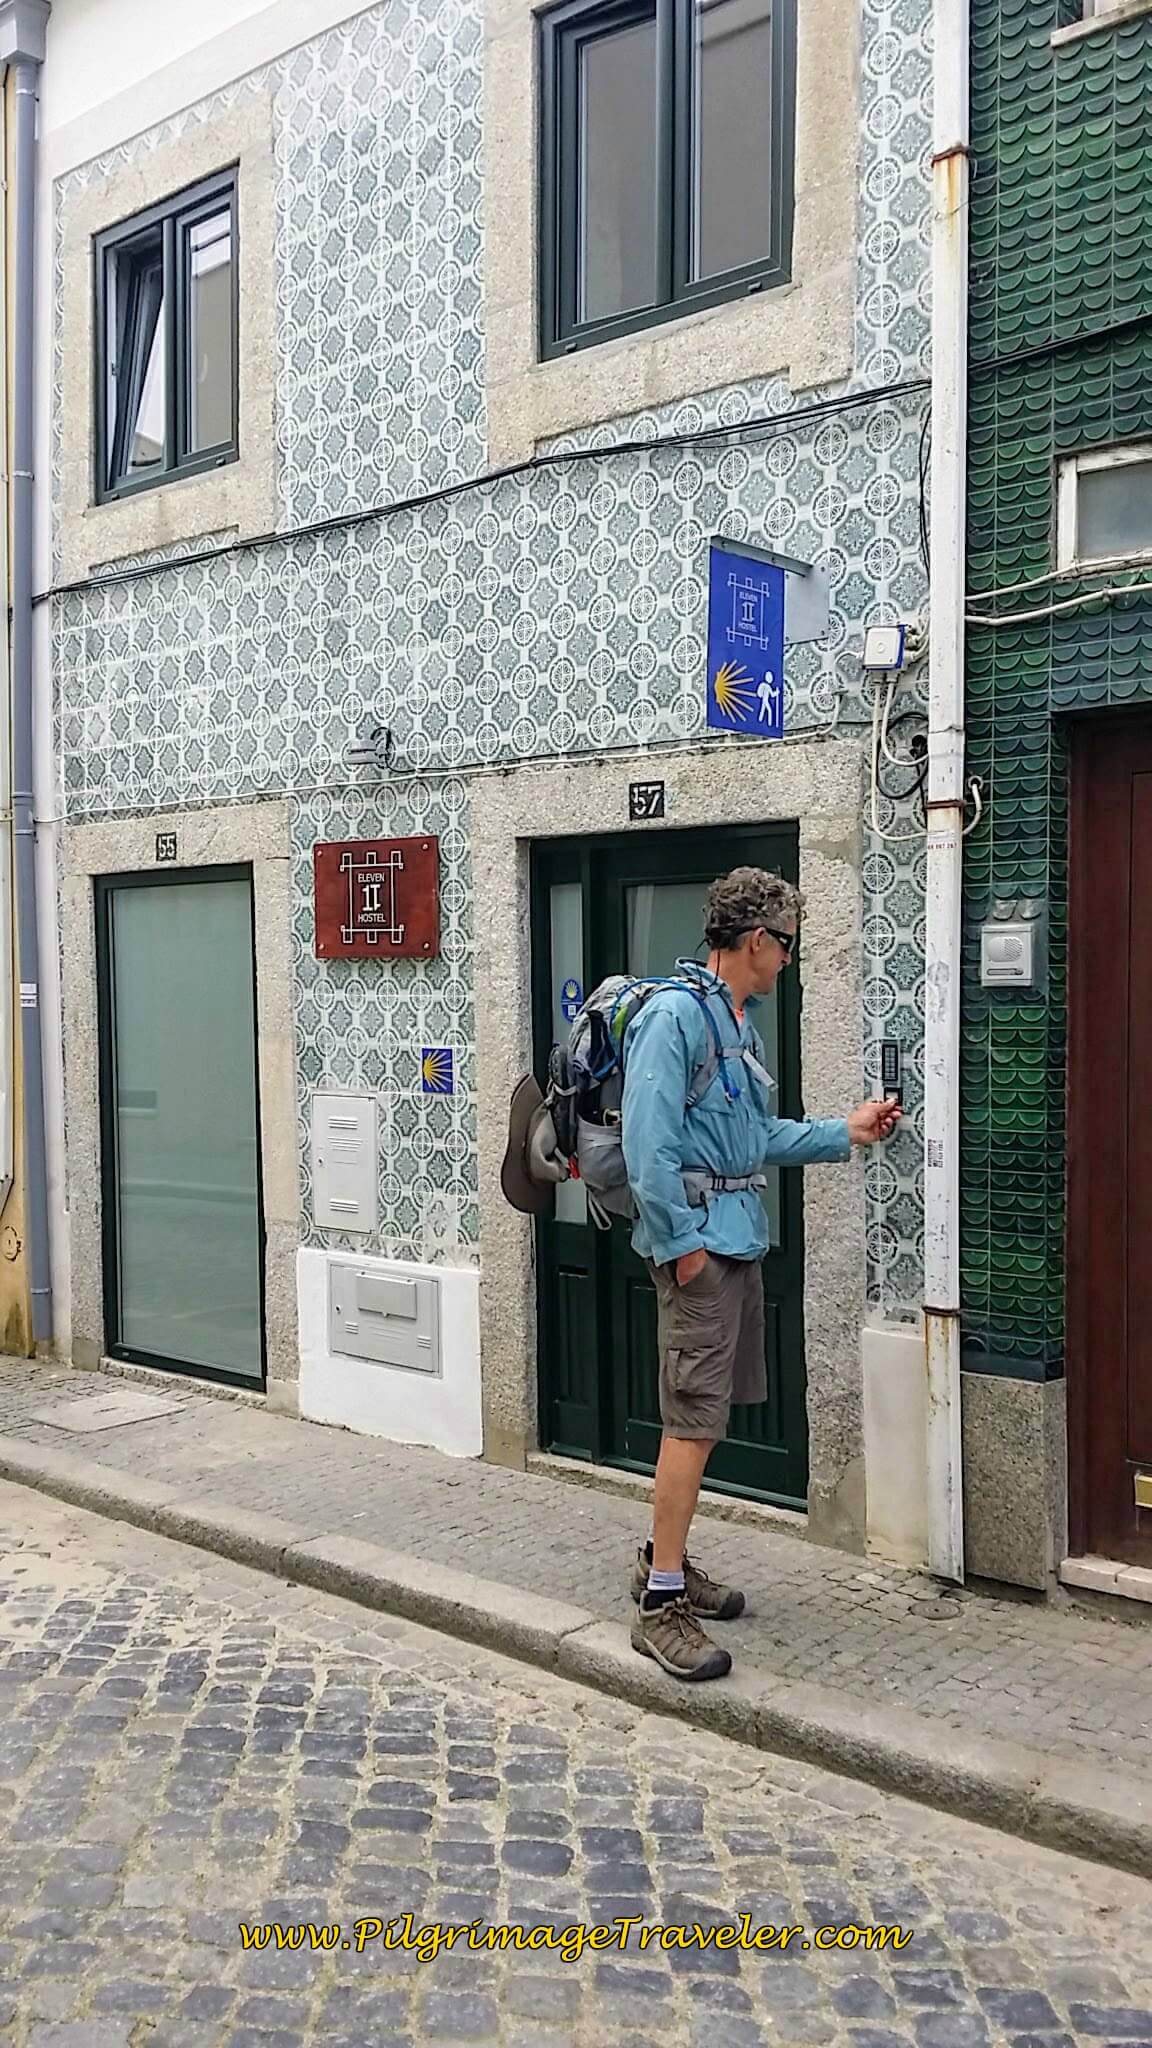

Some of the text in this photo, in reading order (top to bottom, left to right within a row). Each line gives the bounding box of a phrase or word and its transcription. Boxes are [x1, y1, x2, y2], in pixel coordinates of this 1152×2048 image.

[633, 785, 662, 815] 57
[158, 835, 175, 857] 55
[357, 873, 385, 883] ELEVEN
[357, 913, 386, 923] HOSTEL
